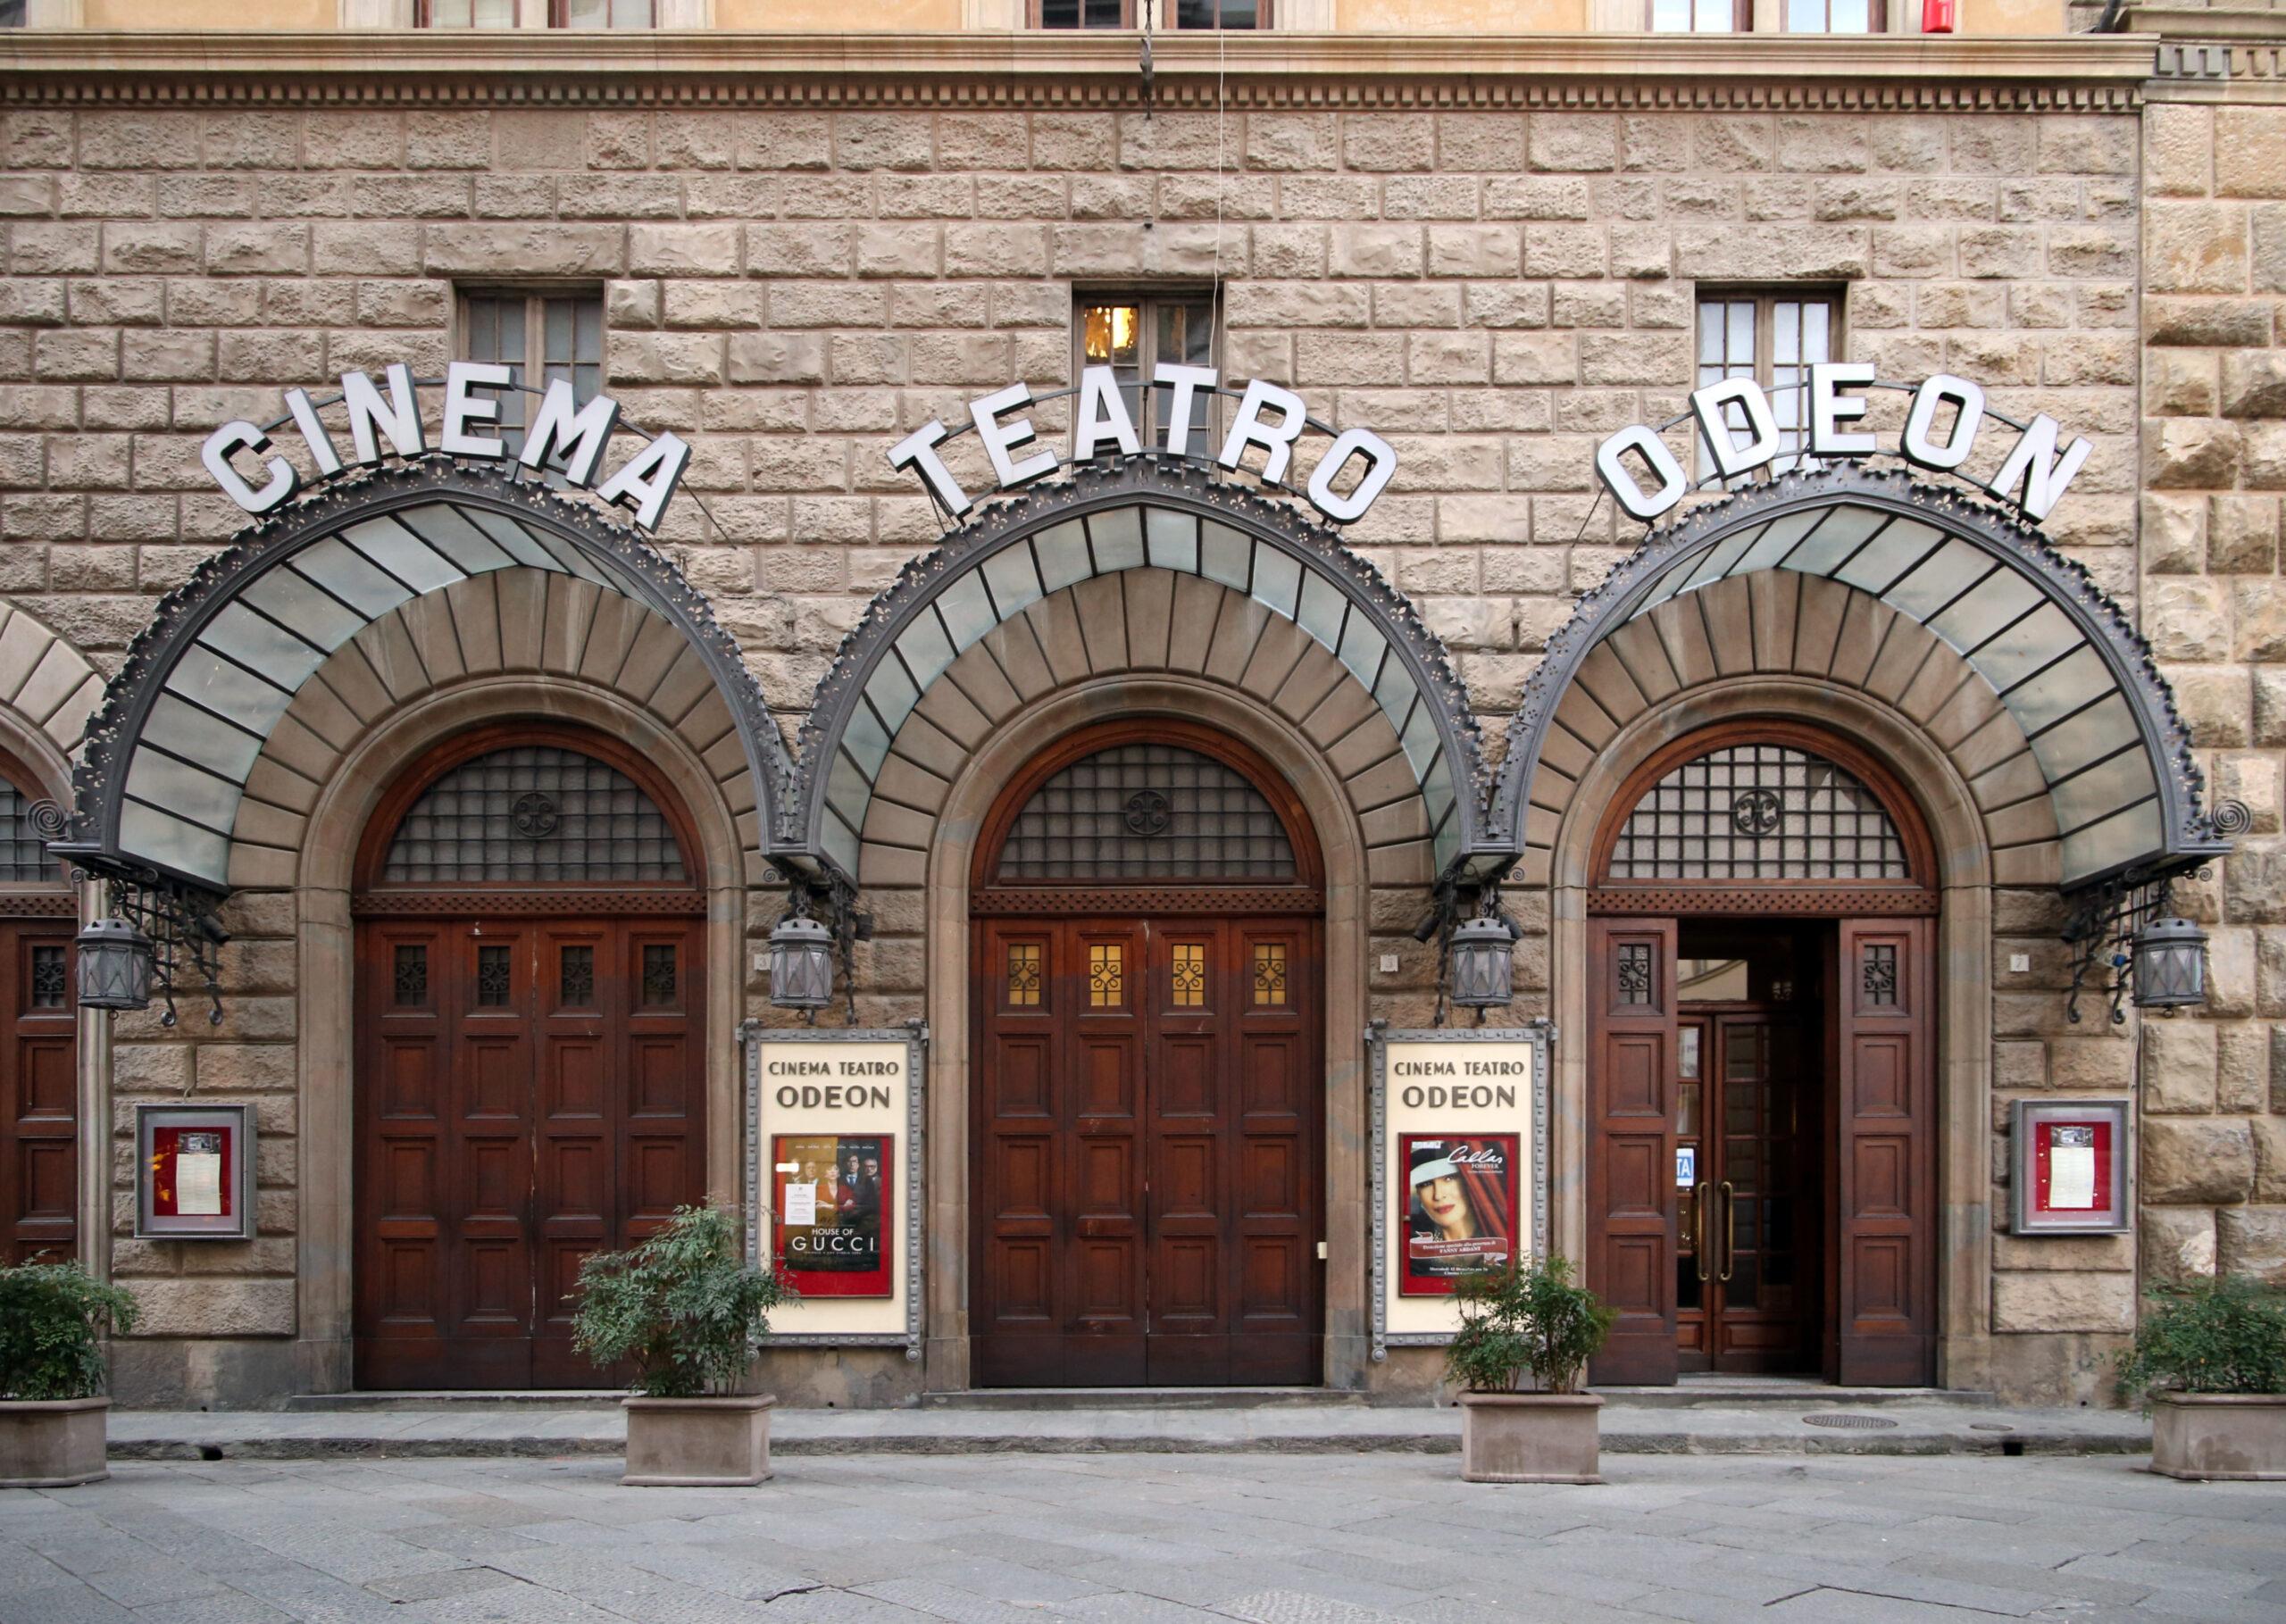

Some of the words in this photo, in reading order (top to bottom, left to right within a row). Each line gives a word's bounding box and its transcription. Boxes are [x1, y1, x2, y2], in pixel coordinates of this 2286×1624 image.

[200, 362, 692, 535] CINEMA
[886, 363, 1397, 525] TEATRO
[1596, 363, 2095, 525] ODEON
[769, 1062, 830, 1075] CINEMA
[839, 1062, 899, 1075] TEATRO
[1394, 1062, 1456, 1075] CINEMA
[1464, 1061, 1524, 1075] TEATRO
[776, 1085, 890, 1108] ODEON
[1402, 1085, 1515, 1108] ODEON
[1448, 1145, 1503, 1163] Callas
[812, 1228, 839, 1236] HOUSE
[842, 1228, 855, 1236] OF
[792, 1236, 874, 1252] GUCCI
